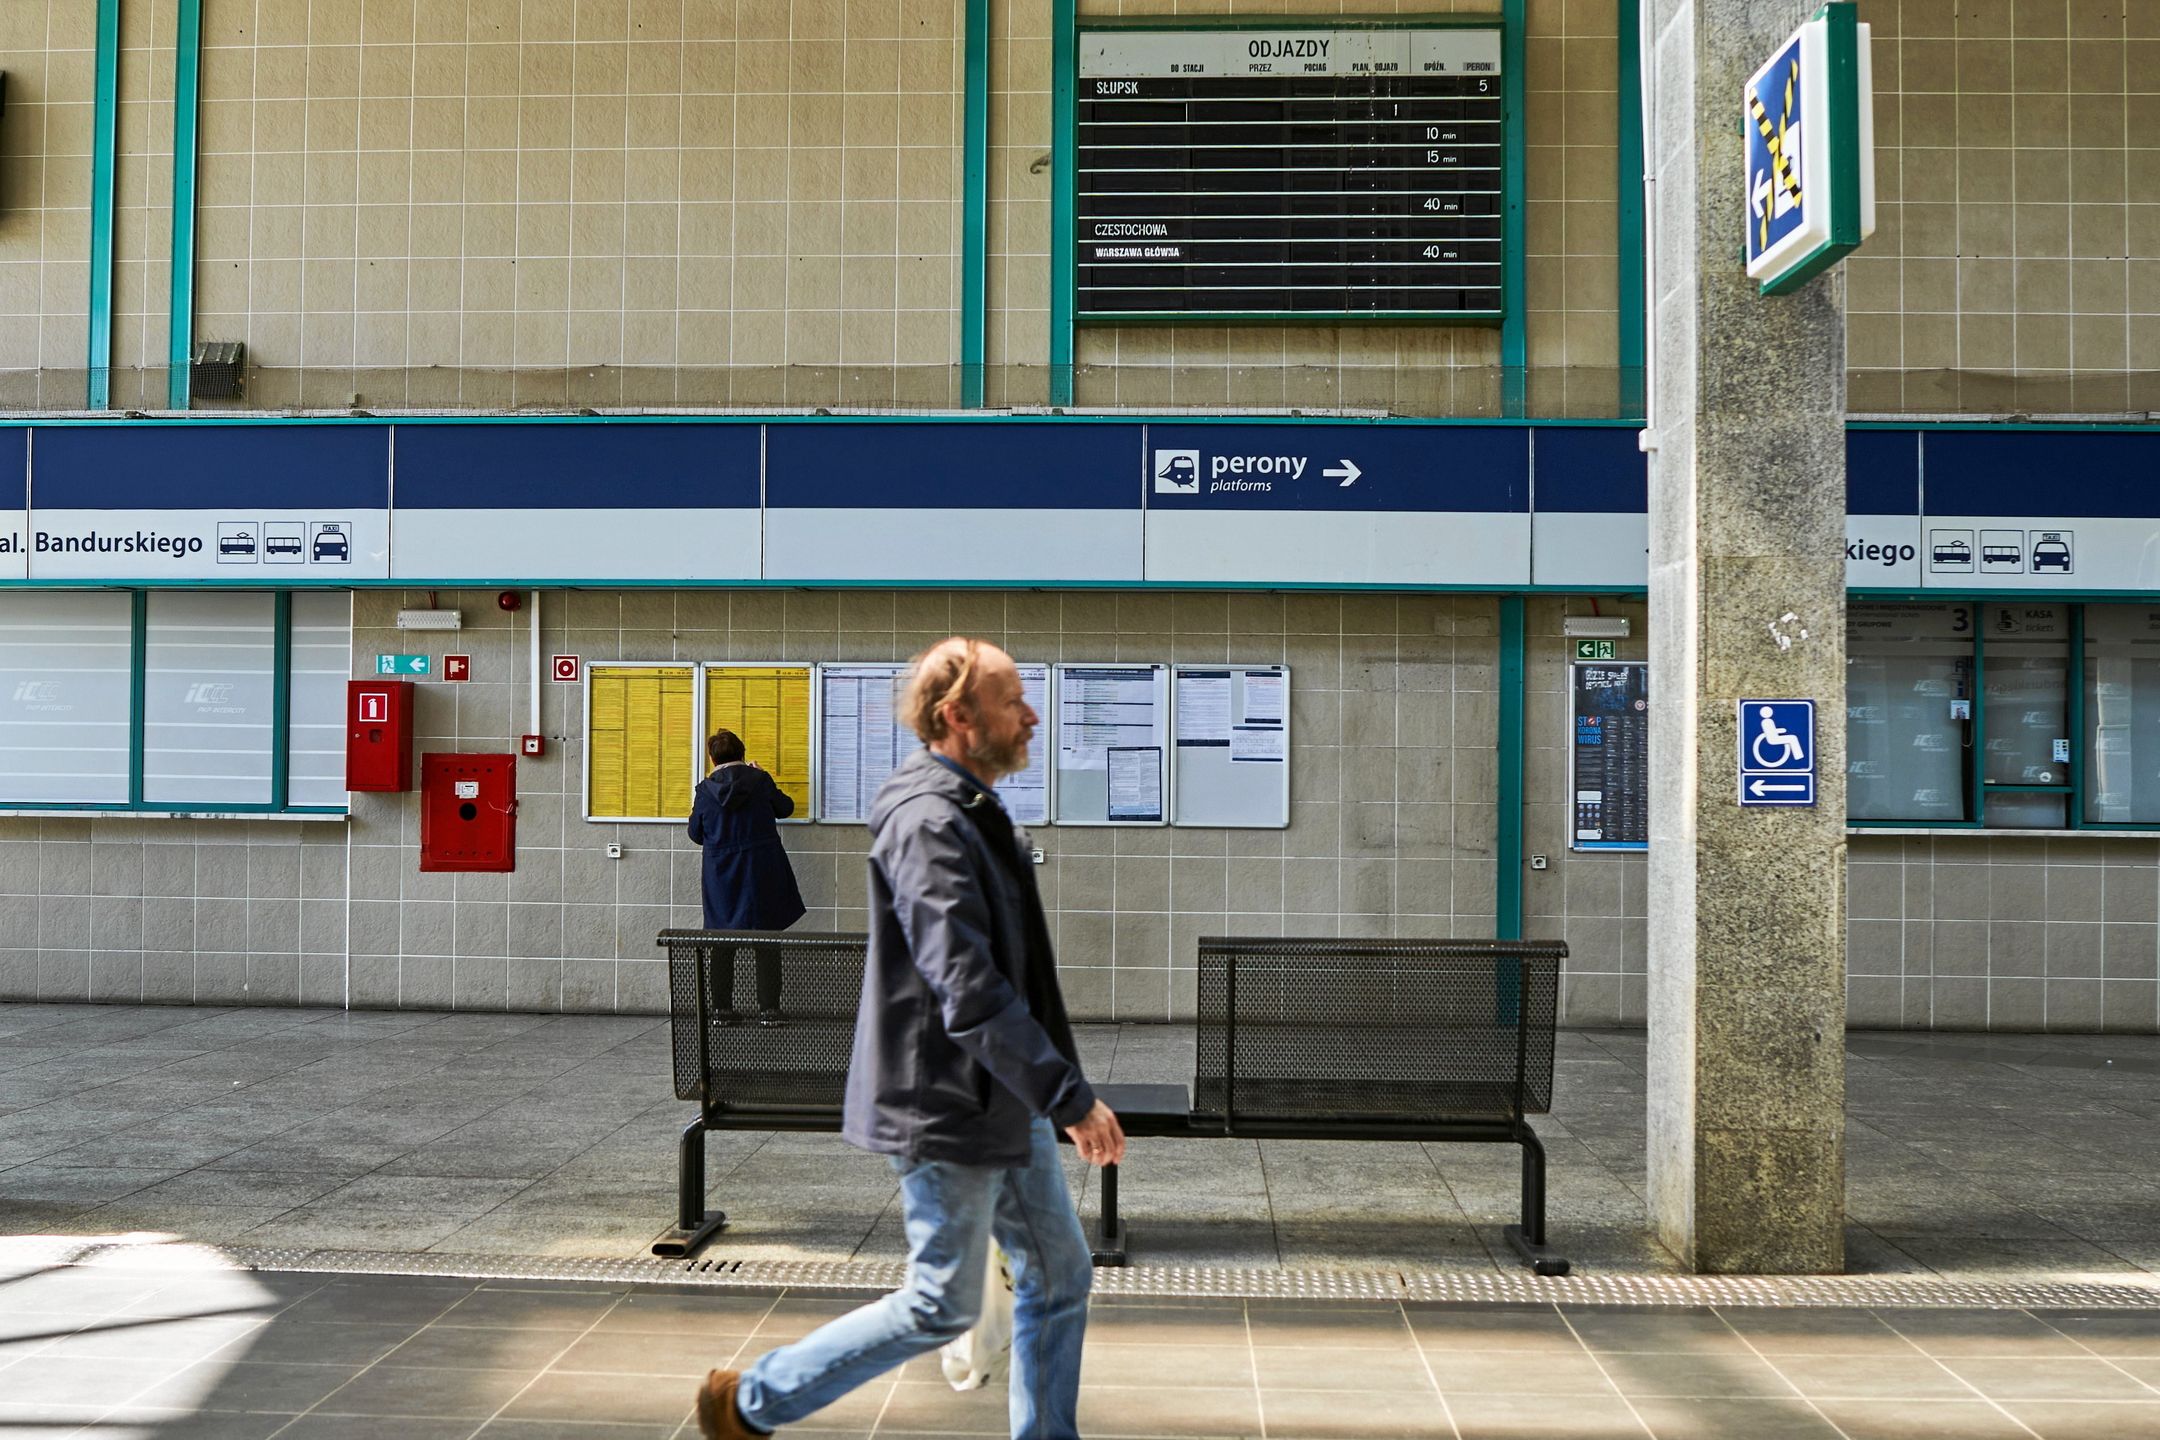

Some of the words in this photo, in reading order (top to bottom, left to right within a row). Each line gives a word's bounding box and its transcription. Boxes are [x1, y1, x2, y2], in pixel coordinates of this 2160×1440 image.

[1248, 39, 1330, 58] ODJAZDY
[1183, 64, 1204, 73] STACJI
[1249, 63, 1272, 73] PRZEZ
[1352, 62, 1371, 72] PLAN.
[1466, 63, 1491, 71] PERON
[1096, 81, 1139, 95] SŁUPSK
[1479, 79, 1488, 93] 5
[1426, 126, 1439, 140] 10
[1442, 132, 1457, 140] min
[1427, 150, 1439, 163] 15
[1423, 197, 1441, 211] 40
[1444, 202, 1458, 210] min
[1095, 247, 1143, 257] WARSZAWA
[1422, 245, 1440, 258] 40
[1443, 250, 1458, 258] min
[1211, 455, 1308, 480] perony
[1210, 478, 1272, 494] platforms
[0, 532, 26, 553] al.
[35, 531, 203, 558] Bandurskiego
[1952, 607, 1969, 631] 3
[2025, 609, 2054, 619] KASA
[1577, 716, 1602, 727] STOP
[1578, 735, 1602, 744] WIRUS
